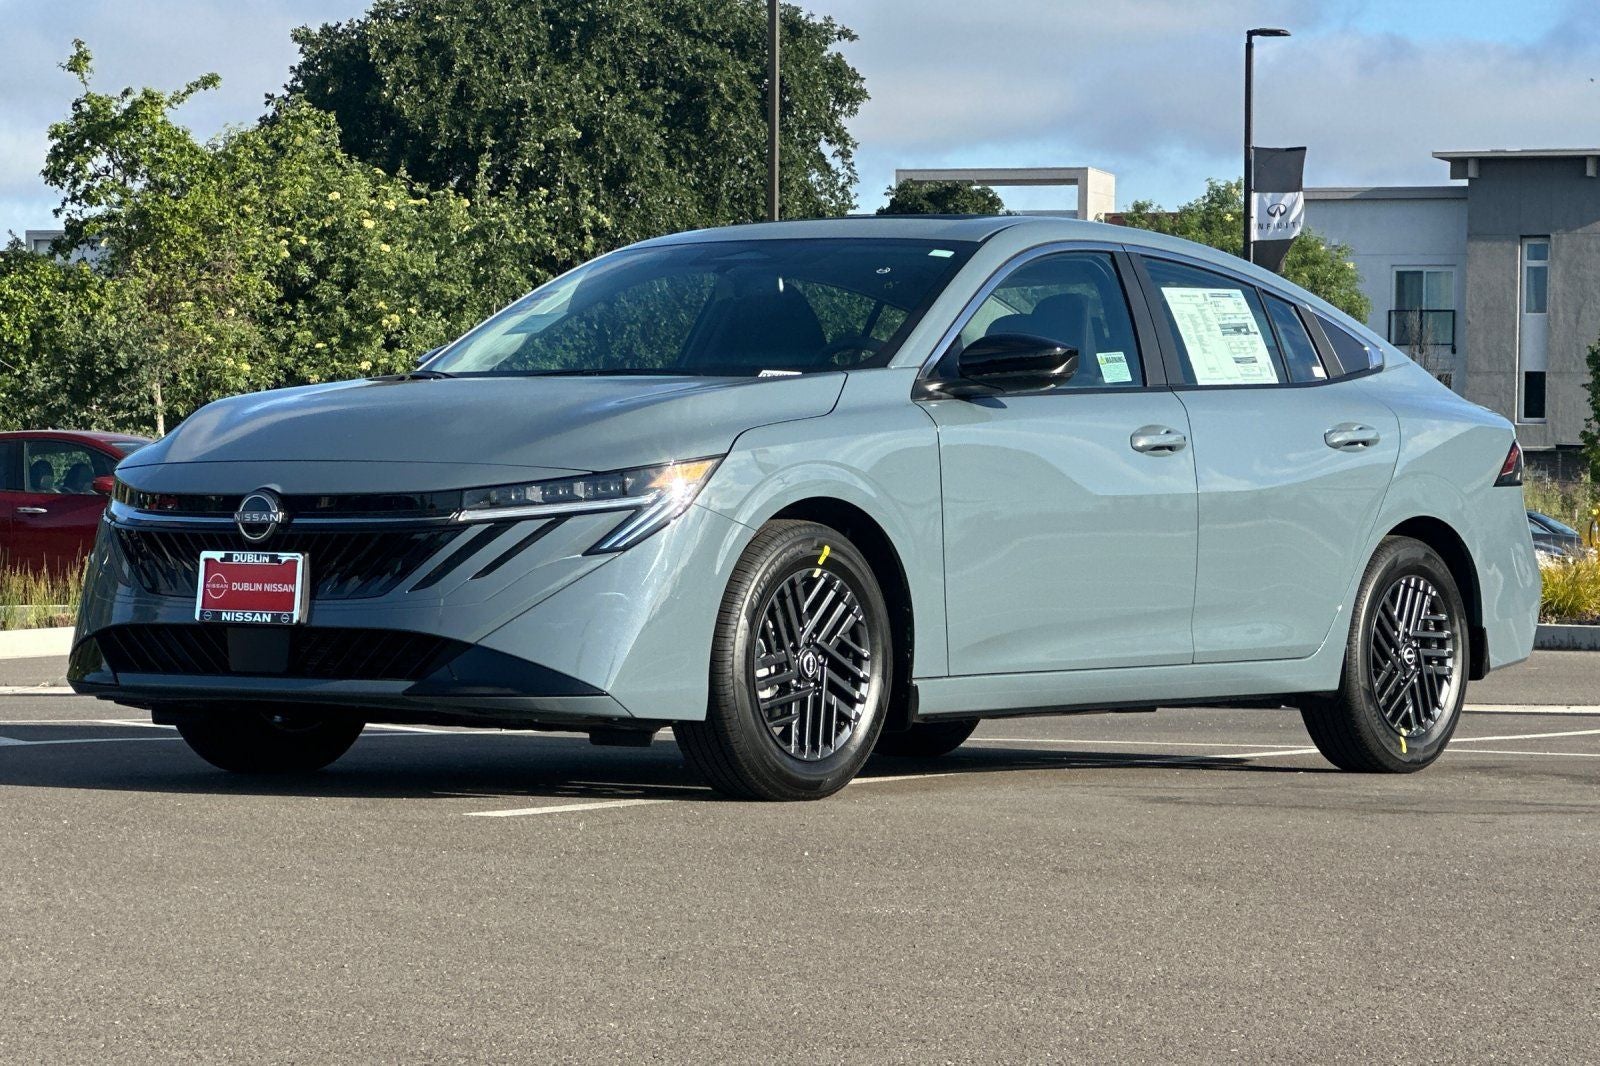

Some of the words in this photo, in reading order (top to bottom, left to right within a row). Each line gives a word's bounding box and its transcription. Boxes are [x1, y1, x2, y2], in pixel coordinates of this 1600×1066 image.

[234, 513, 279, 522] NISSAN
[232, 553, 270, 563] DUBLIN
[231, 582, 262, 592] DUBLIN
[263, 583, 295, 593] NISSAN
[221, 612, 272, 623] NISSAN
